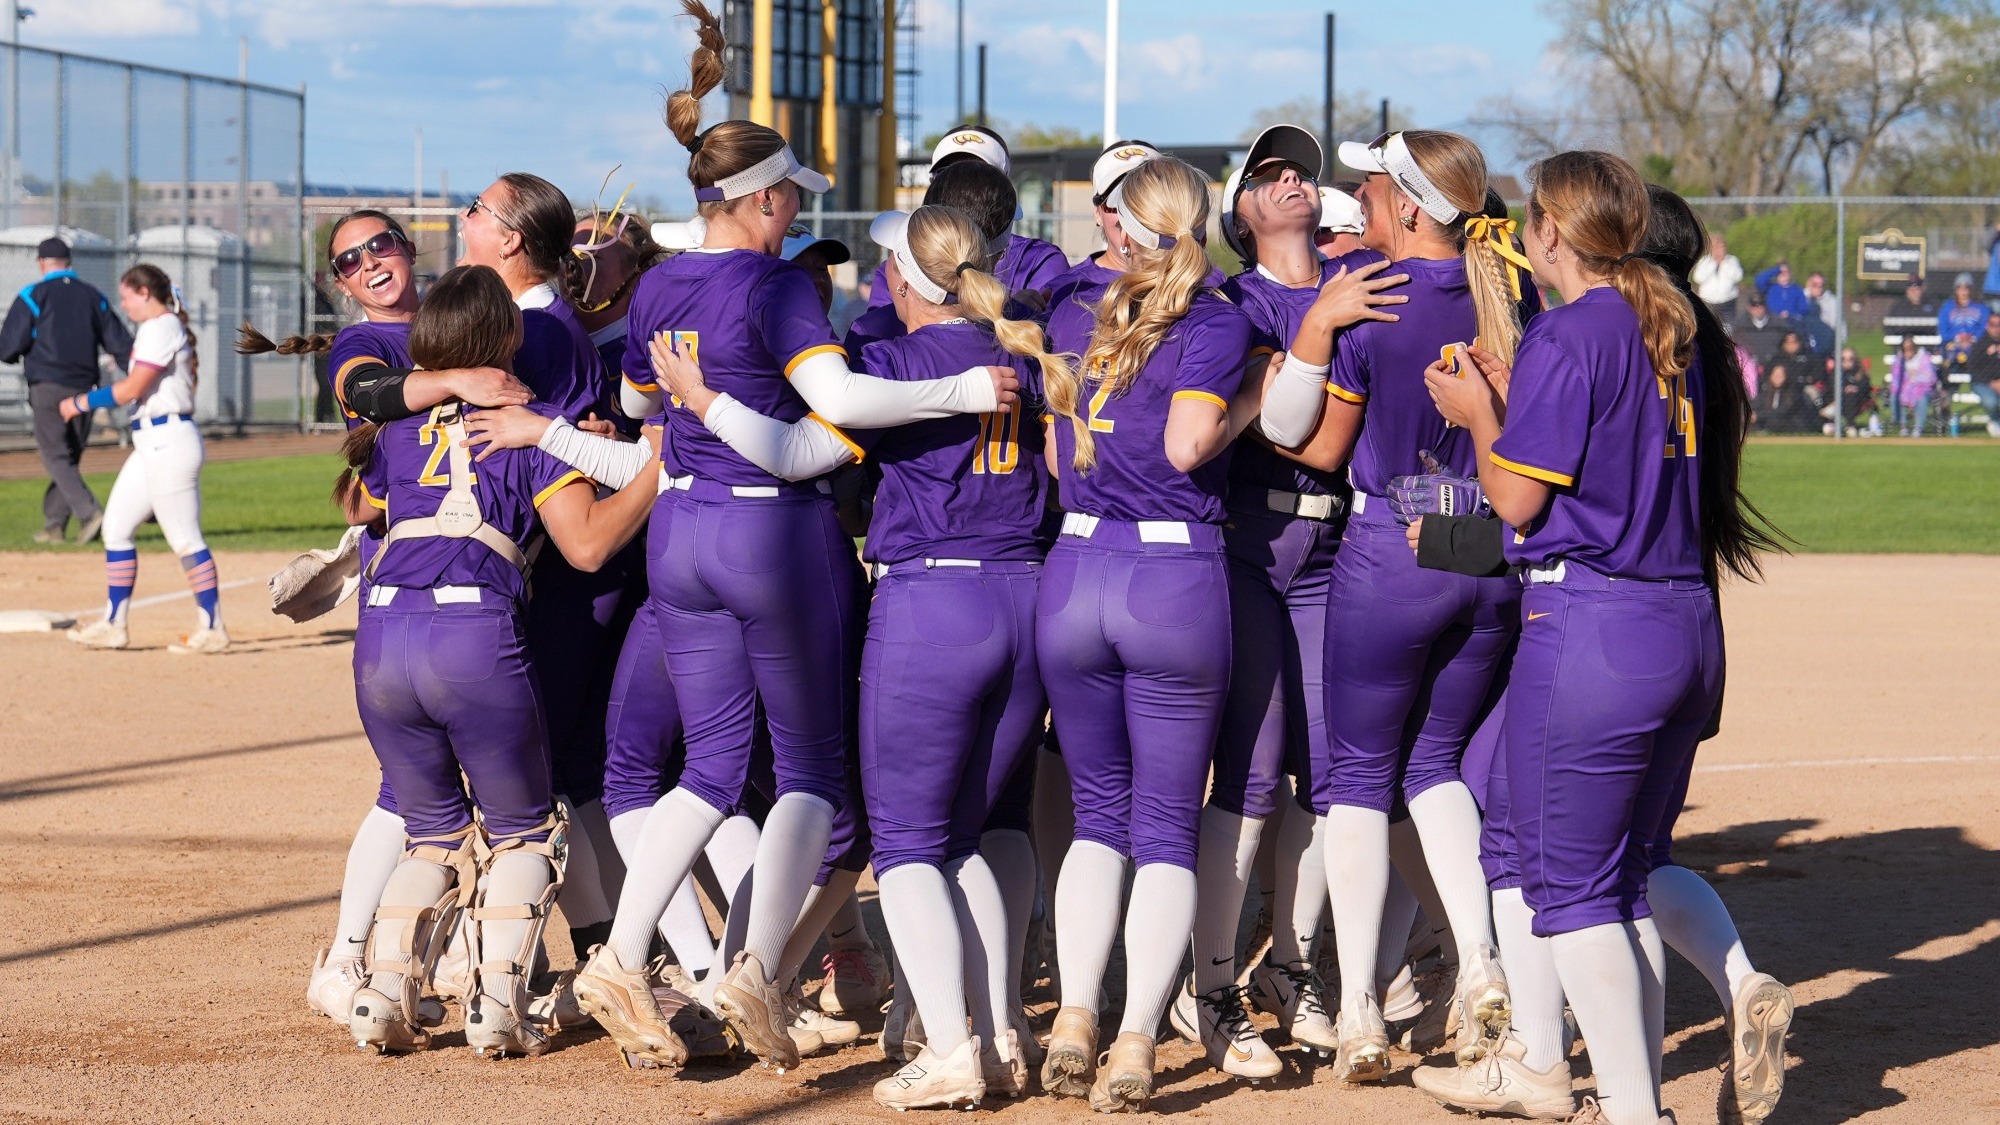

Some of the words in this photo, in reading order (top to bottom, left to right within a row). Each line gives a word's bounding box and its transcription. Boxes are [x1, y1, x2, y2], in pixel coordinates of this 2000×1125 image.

[418, 421, 478, 486] 2
[972, 394, 1021, 474] 10
[1442, 485, 1450, 516] ranklin
